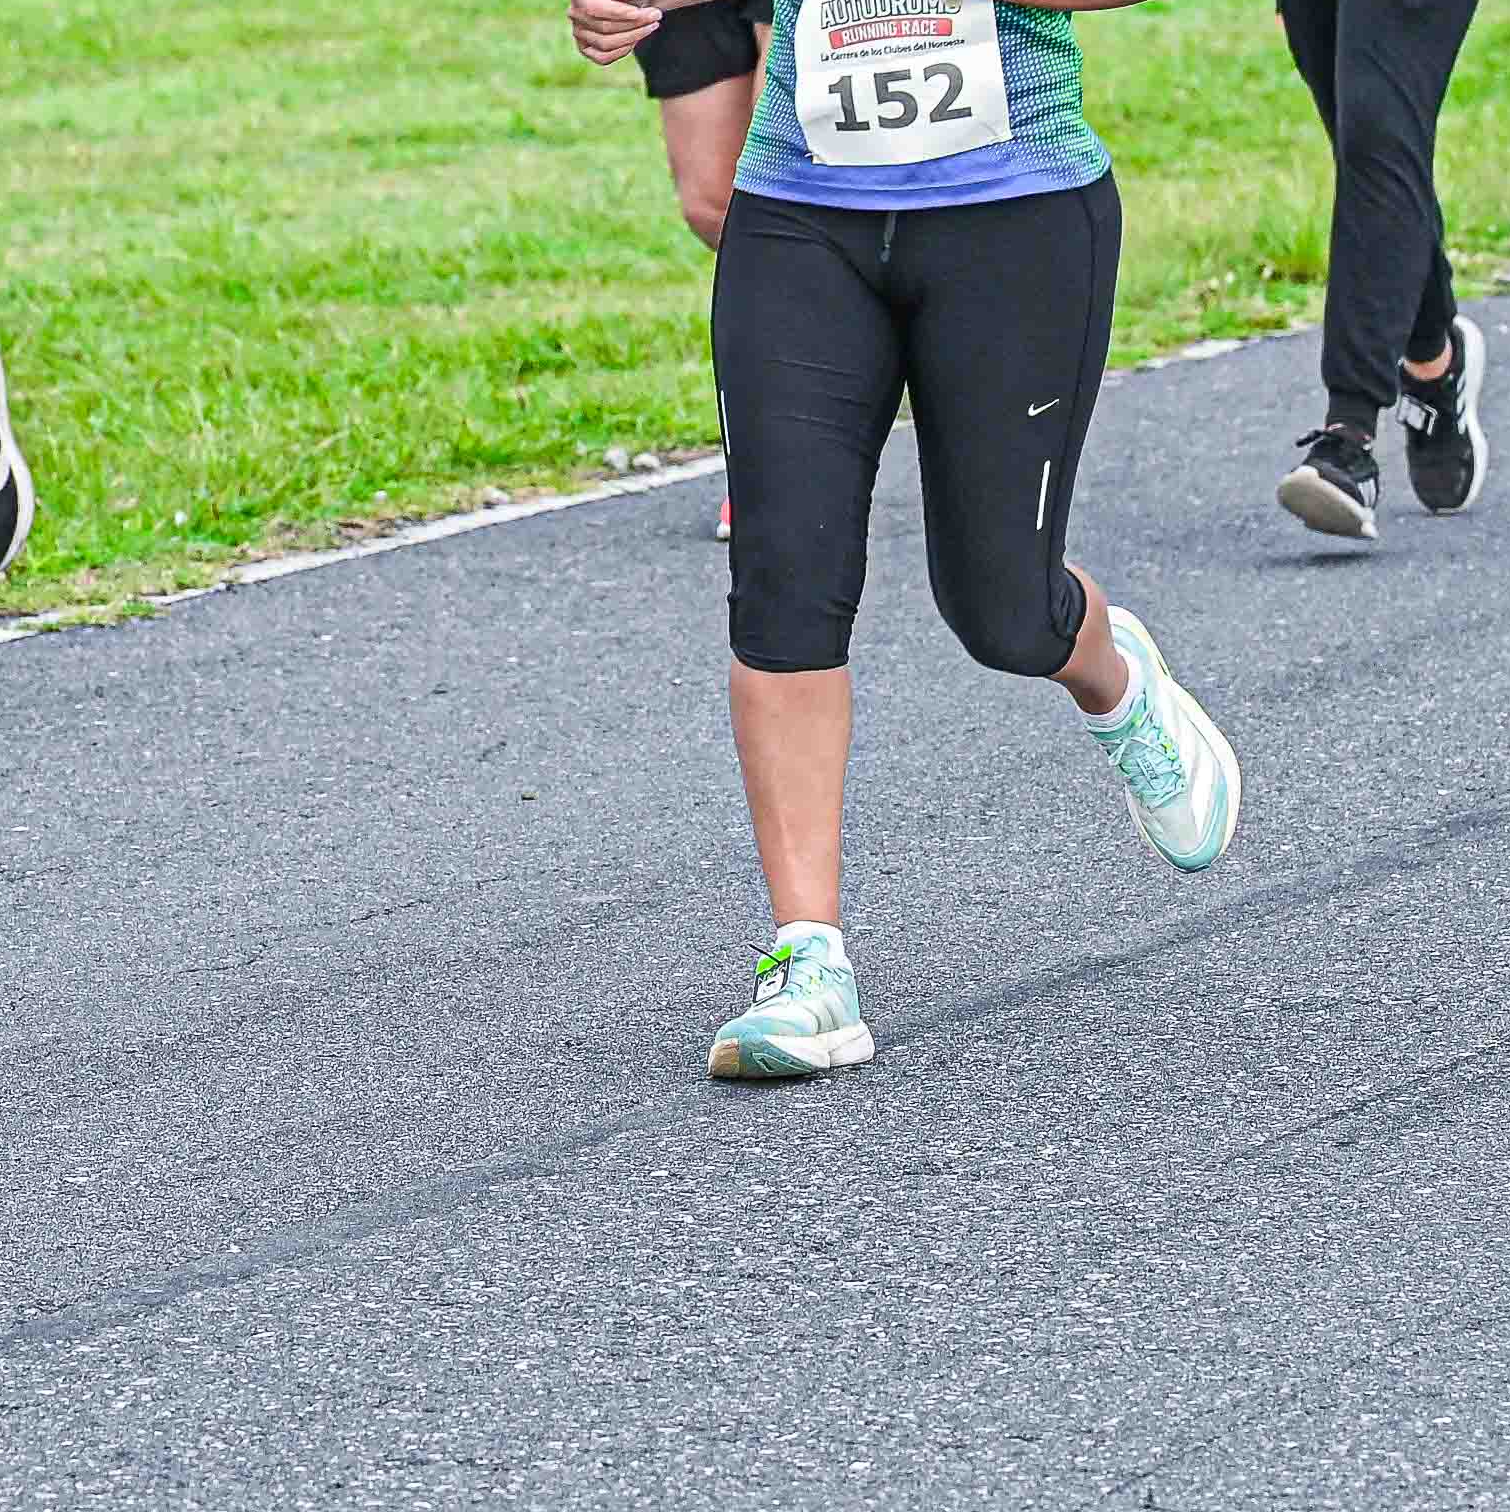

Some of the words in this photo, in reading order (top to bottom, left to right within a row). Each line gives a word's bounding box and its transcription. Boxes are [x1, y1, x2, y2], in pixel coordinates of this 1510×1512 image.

[841, 21, 897, 45] RUNNING
[902, 19, 939, 37] RACE
[820, 52, 829, 62] La
[828, 62, 973, 132] 152
